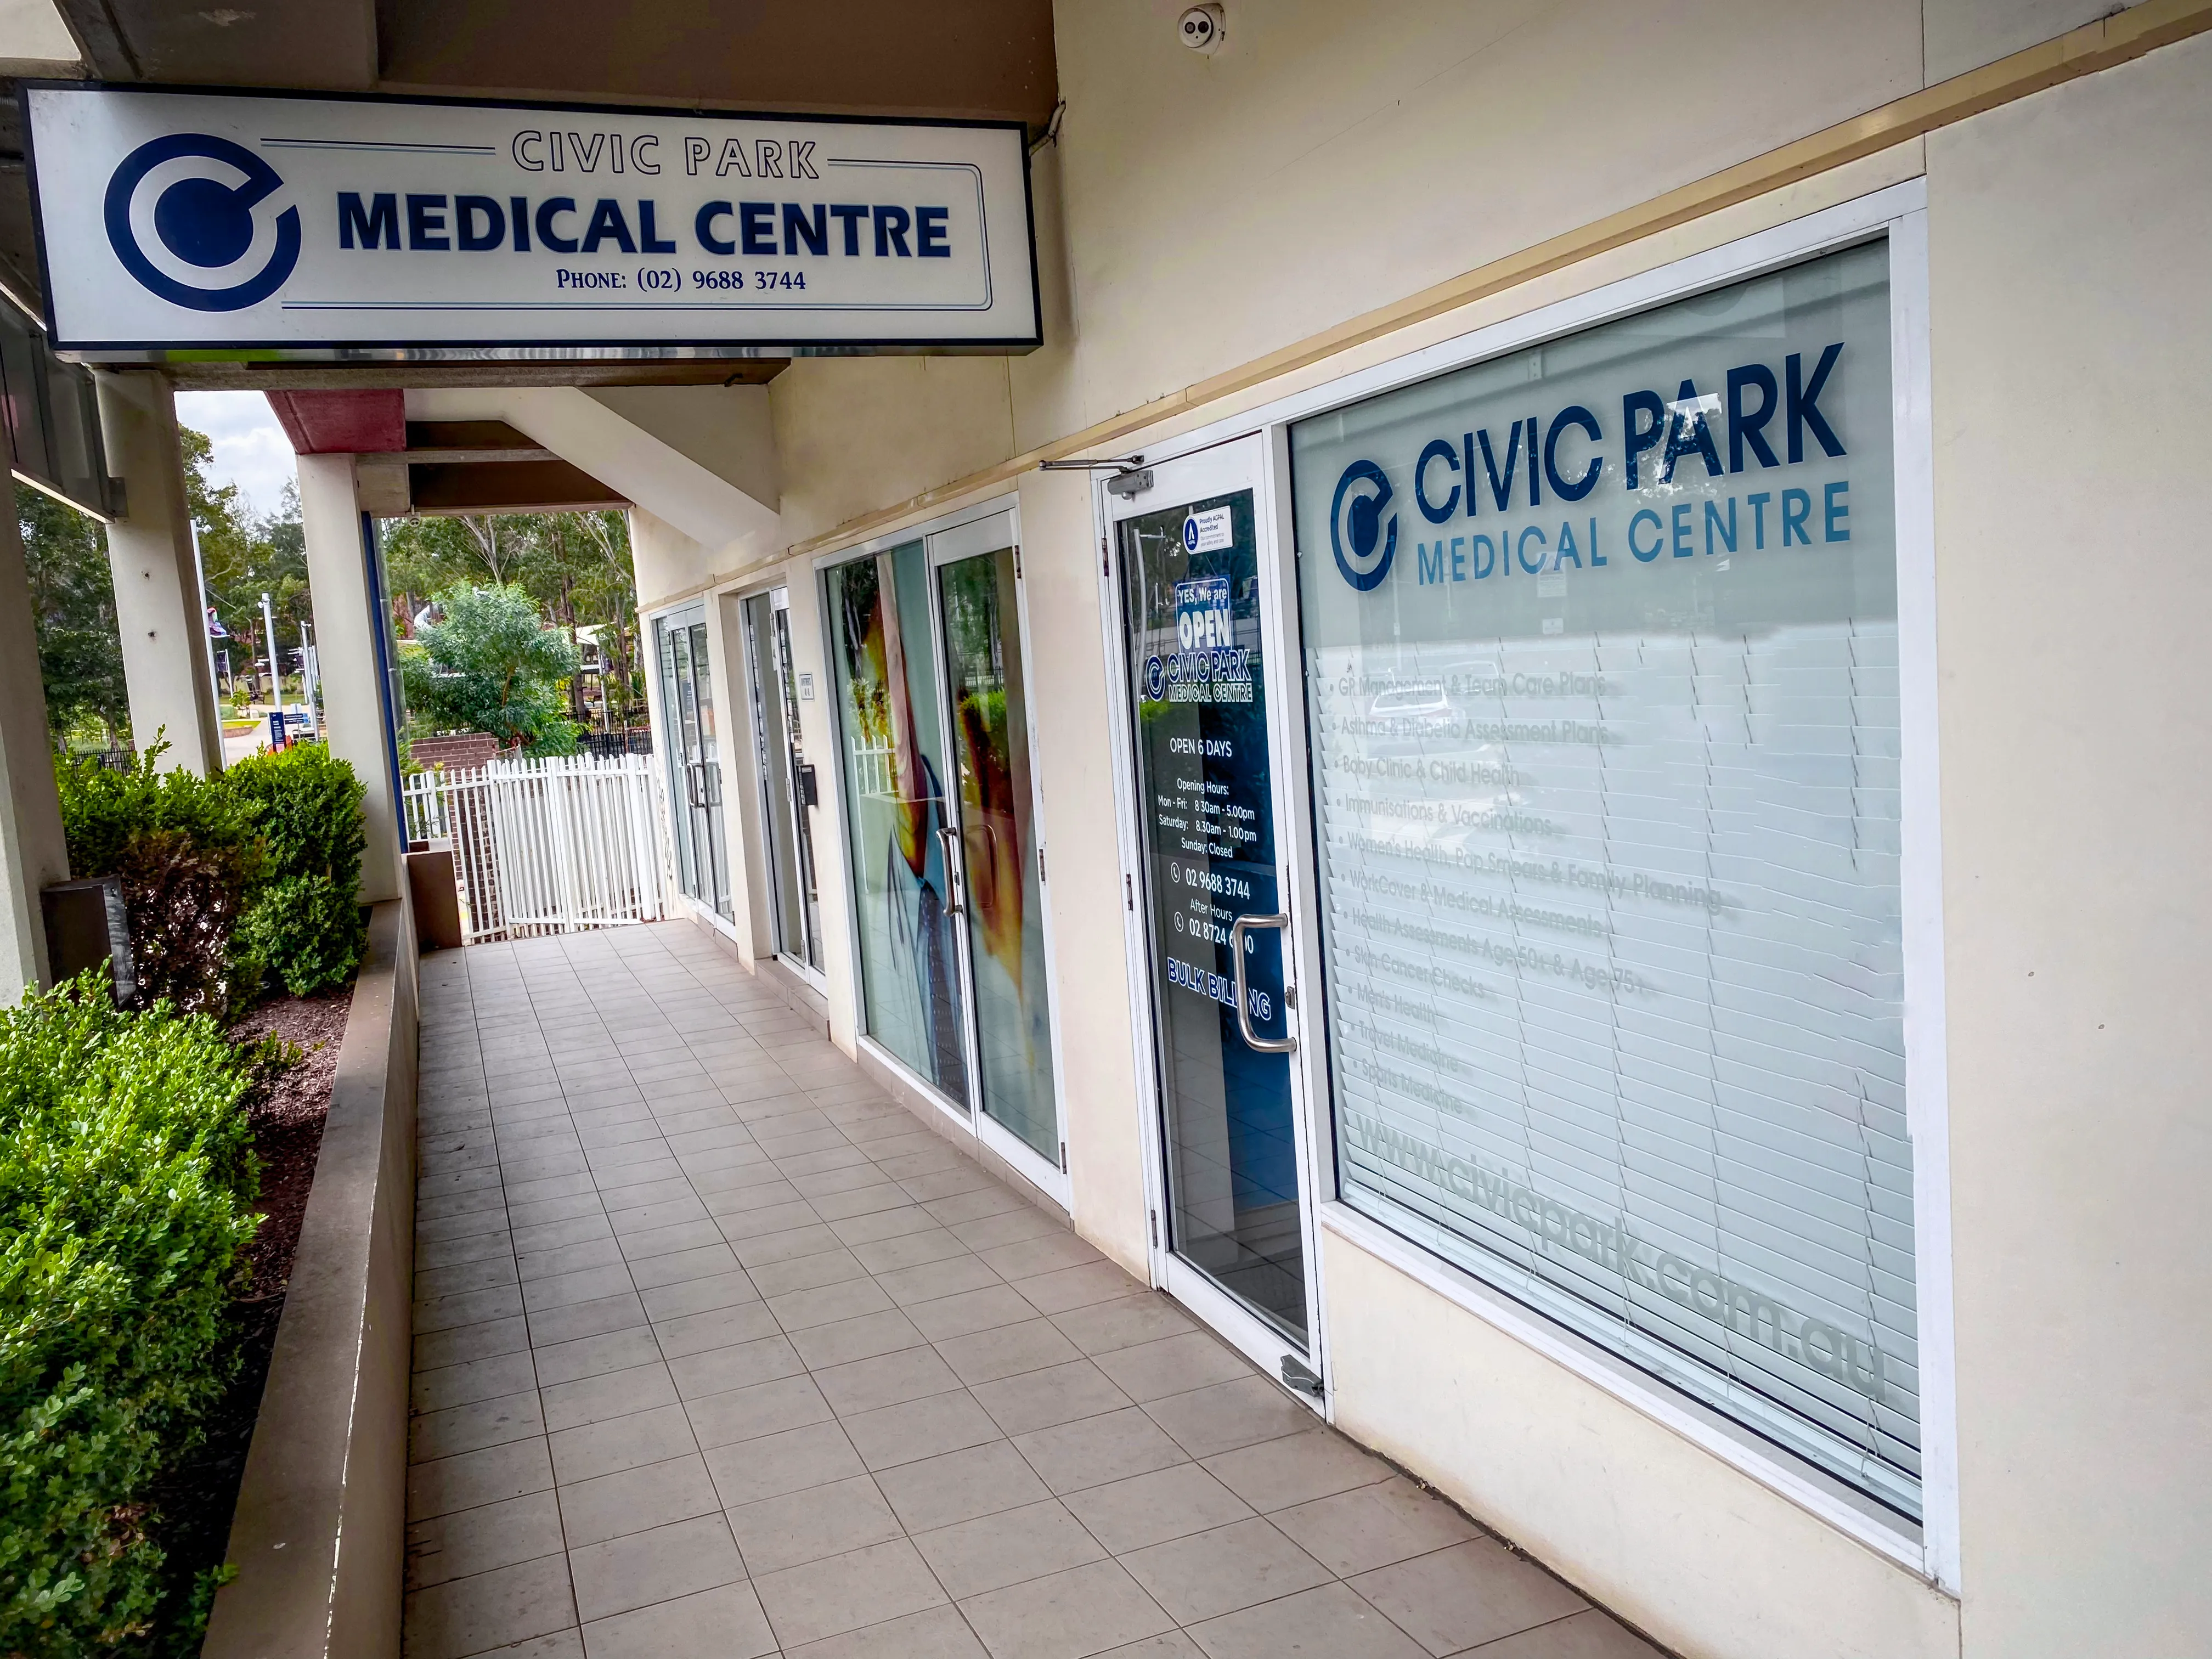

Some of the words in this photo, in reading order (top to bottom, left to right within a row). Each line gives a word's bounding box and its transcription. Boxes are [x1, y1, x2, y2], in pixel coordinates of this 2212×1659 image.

[512, 129, 661, 175] CIVIC
[685, 137, 819, 179] PARK
[336, 191, 677, 255] MEDICAL
[695, 200, 951, 258] CENTRE
[637, 267, 681, 292] (02)
[692, 269, 743, 290] 9688
[755, 270, 806, 290] 3744
[1414, 405, 1602, 524] CIVIC
[1623, 342, 1847, 490] PARK
[1200, 516, 1212, 524] Proudly
[1200, 523, 1218, 533] Accredited
[1418, 516, 1607, 586] MEDICAL
[1628, 480, 1850, 563] CENTRE
[1178, 589, 1197, 605] YES,
[1199, 587, 1211, 601] We
[1214, 588, 1227, 600] are
[1180, 608, 1230, 650] OPEN
[1167, 651, 1210, 684] CIVIC
[1211, 648, 1252, 682] PARK
[1168, 684, 1212, 702] MEDICAL
[1213, 683, 1253, 702] CENTRE
[1359, 674, 1447, 701] Management
[1451, 674, 1460, 696] &
[1465, 674, 1508, 696] Team
[1513, 673, 1553, 696] Care
[1560, 671, 1606, 695] Plans
[1170, 737, 1195, 754] OPEN
[1198, 739, 1204, 755] 6
[1206, 740, 1232, 757] DAYS
[1341, 716, 1385, 736] Asthma
[1390, 717, 1398, 737] &
[1465, 719, 1556, 741] Assessment
[1562, 720, 1609, 744] Plans
[1177, 778, 1204, 794] Opening
[1206, 781, 1229, 795] Hours:
[1343, 755, 1372, 779] Baby
[1376, 757, 1412, 778] Clinic
[1416, 758, 1425, 779] &
[1430, 760, 1466, 783] Child
[1471, 763, 1520, 786] Health
[1158, 795, 1171, 808] Mon
[1177, 797, 1188, 810] Fri:
[1227, 805, 1255, 821] 5.00pm
[1345, 793, 1433, 821] Immunisations
[1438, 803, 1447, 823] &
[1452, 804, 1553, 834] Vaccinations
[1159, 814, 1189, 831] Saturday:
[1196, 820, 1222, 836] 8.30am
[1228, 826, 1257, 843] 1.00pm
[1181, 837, 1207, 855] Sunday:
[1209, 842, 1233, 858] Closed
[1186, 867, 1197, 887] 02
[1199, 871, 1223, 894] 9688
[1225, 877, 1250, 900] 3744
[1347, 831, 1401, 858] Women's
[1405, 839, 1452, 870] Health,
[1456, 847, 1483, 874] Pap
[1488, 851, 1545, 881] Smears
[1551, 861, 1562, 883] &
[1568, 864, 1626, 899] Family
[1633, 872, 1722, 916] Planning
[1190, 898, 1207, 915] After
[1210, 904, 1233, 922] Hours
[1350, 868, 1416, 900] WorkCover
[1421, 882, 1431, 902] &
[1434, 884, 1492, 916] Medical
[1498, 898, 1602, 938] Assessments
[1189, 918, 1201, 938] 02
[1203, 922, 1226, 945] 8724
[1229, 930, 1254, 954] 60
[1352, 907, 1390, 934] Health
[1394, 917, 1478, 955] Assessments
[1483, 938, 1514, 967] Age
[1553, 953, 1564, 978] &
[1571, 958, 1607, 990] Age
[1167, 956, 1207, 996] BULK
[1207, 972, 1271, 1021] BILLNG
[1355, 945, 1378, 968] Skin
[1381, 952, 1427, 983] Cancer
[1432, 966, 1485, 998] Checks
[1357, 982, 1391, 1011] Men's
[1394, 994, 1435, 1024] Health
[1359, 1019, 1394, 1049] Travel
[1397, 1033, 1458, 1073] Medicine
[1362, 1058, 1398, 1088] Sports
[1401, 1073, 1463, 1114] Medicine
[1355, 1113, 1886, 1401] www.civicpark.com.au
